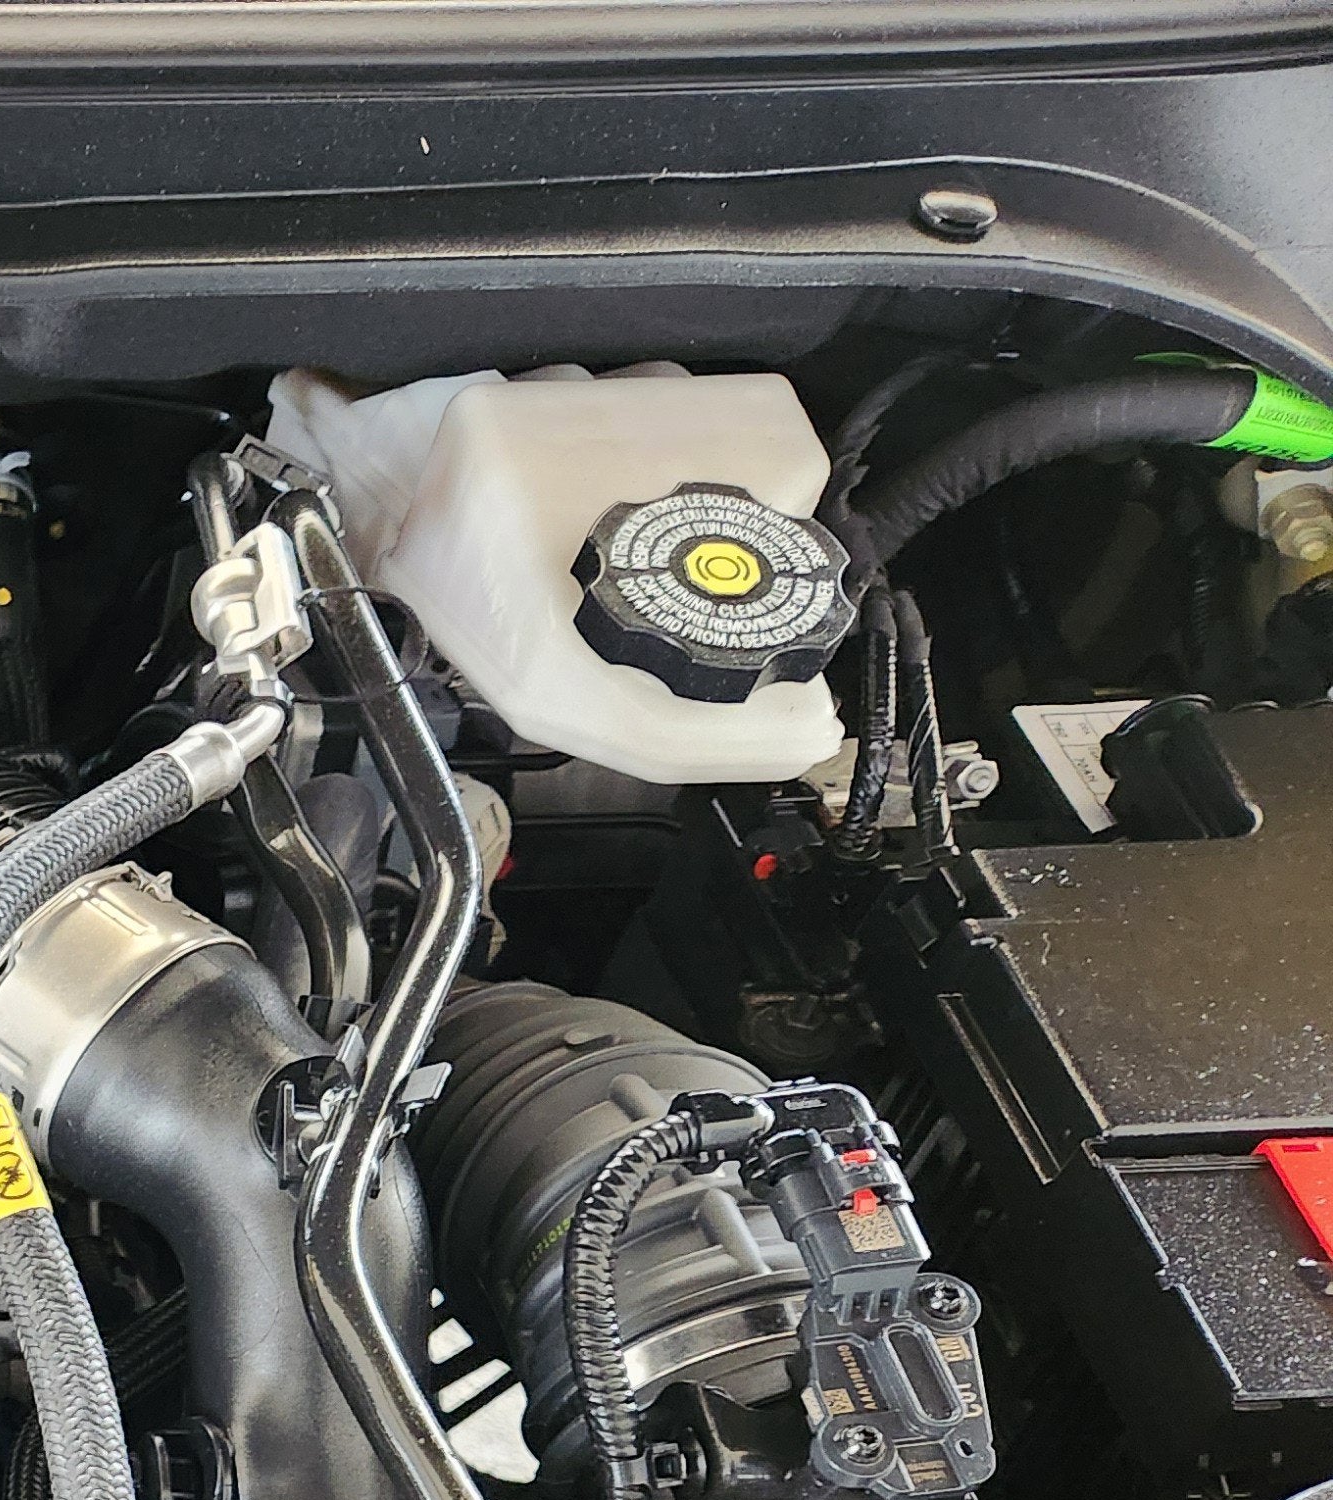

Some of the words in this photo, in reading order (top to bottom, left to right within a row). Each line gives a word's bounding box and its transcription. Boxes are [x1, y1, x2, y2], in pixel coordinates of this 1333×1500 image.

[700, 493, 764, 517] BOUCHON
[758, 507, 805, 536] AVANT
[745, 515, 768, 532] DE
[721, 522, 761, 544] BIDON
[634, 574, 666, 599] CAP
[651, 593, 708, 628] BEFORE
[717, 600, 769, 618] CLEAN
[636, 602, 685, 635] FLUID
[678, 623, 727, 647] FROM
[726, 633, 741, 648] A
[739, 624, 798, 648] SEALED
